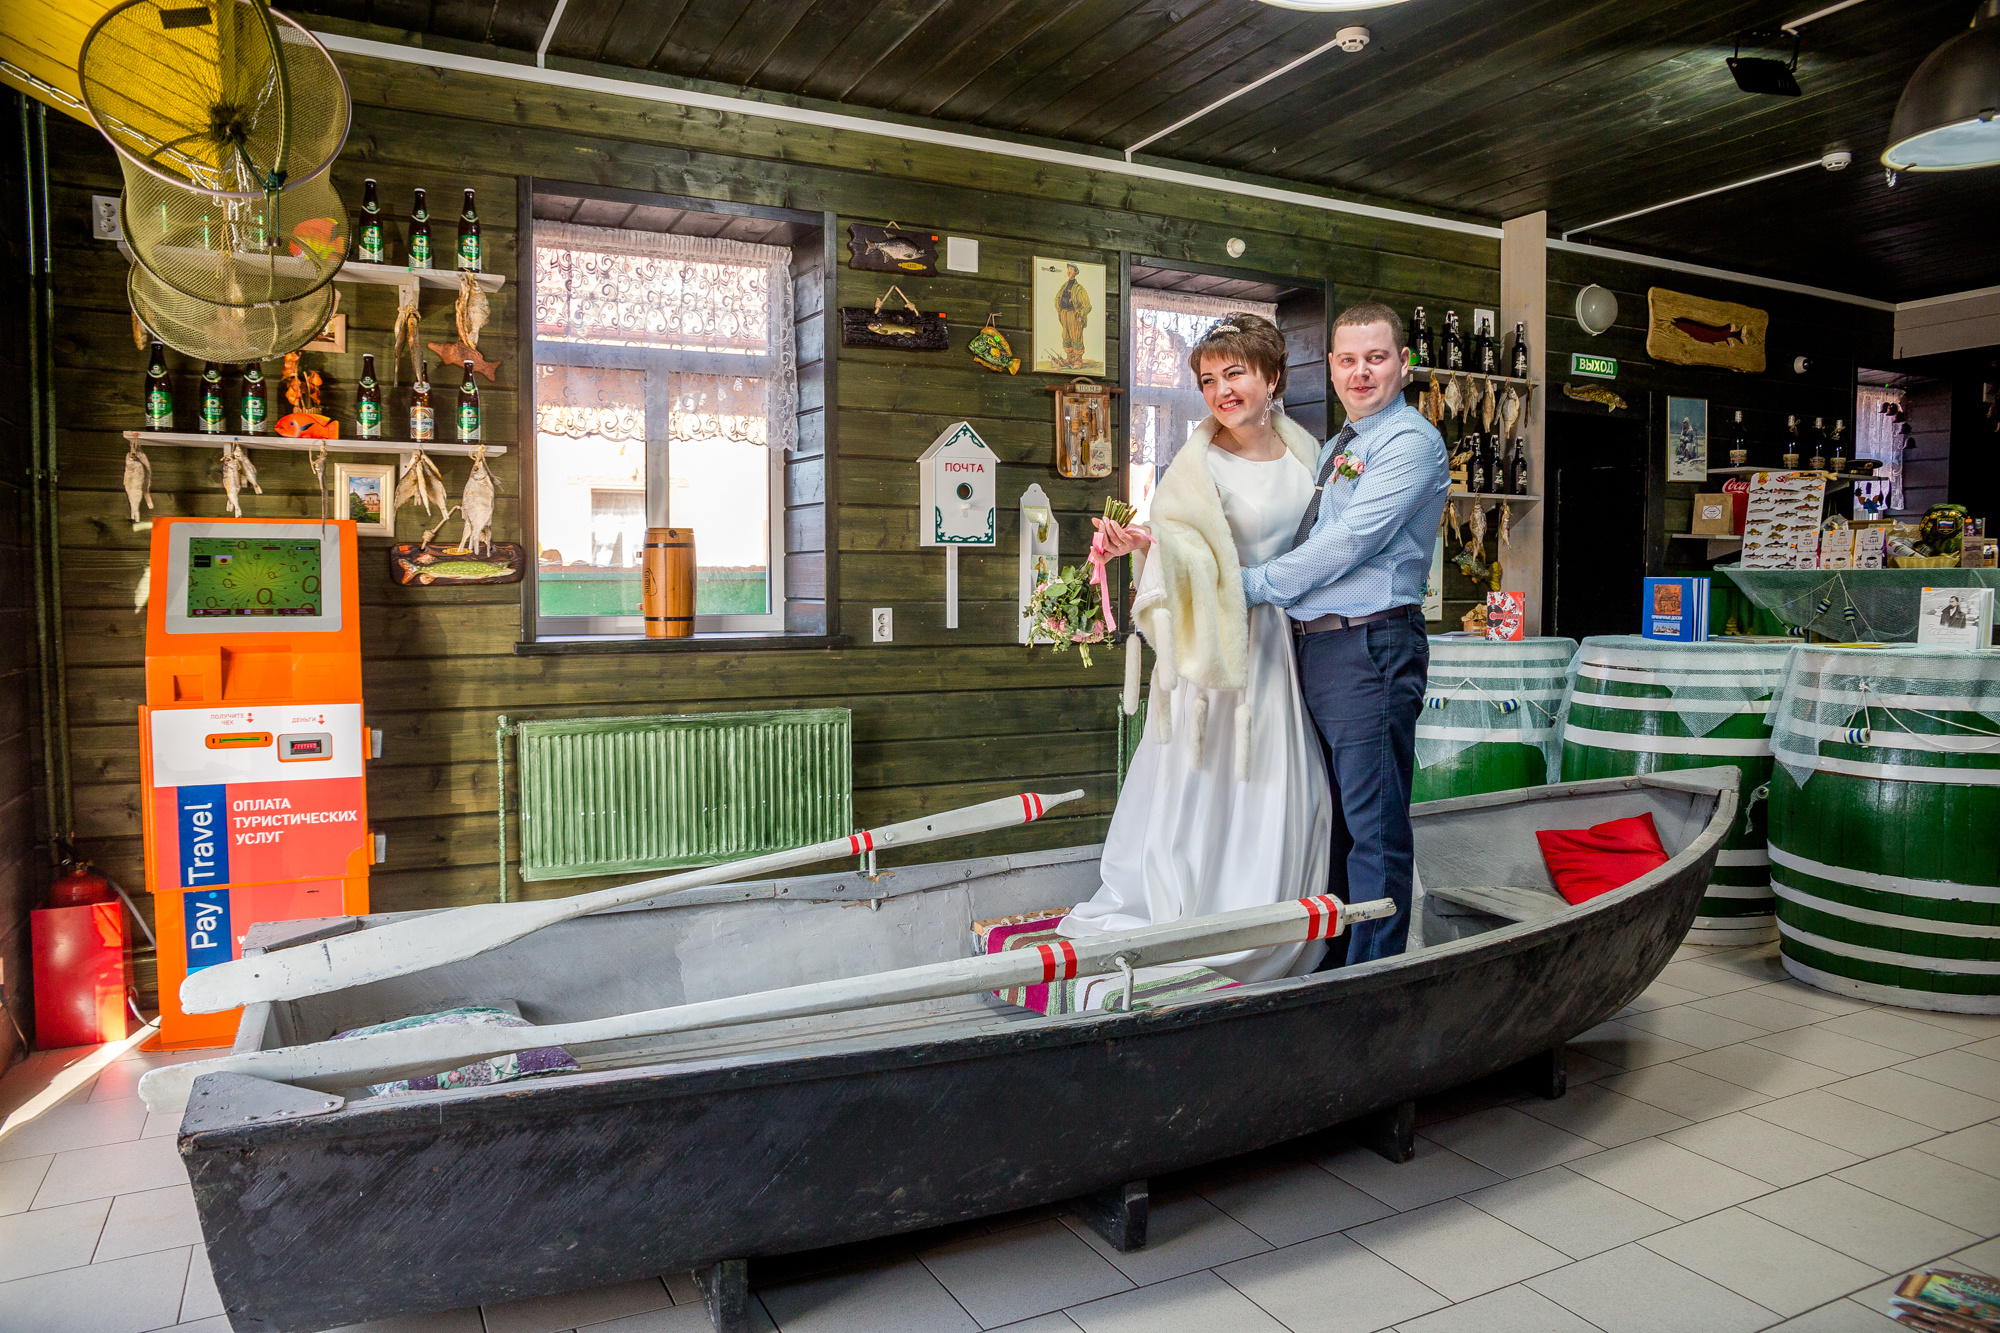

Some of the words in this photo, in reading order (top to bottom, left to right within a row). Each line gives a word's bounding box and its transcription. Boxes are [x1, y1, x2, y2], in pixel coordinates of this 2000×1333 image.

[1579, 358, 1614, 374] ВЫХОД
[944, 462, 984, 473] ПОЧТА
[233, 798, 291, 812] ОПЛАТА
[233, 810, 357, 828] ТУРИСТИЧЕСКИХ
[235, 831, 284, 845] УСЛУГ
